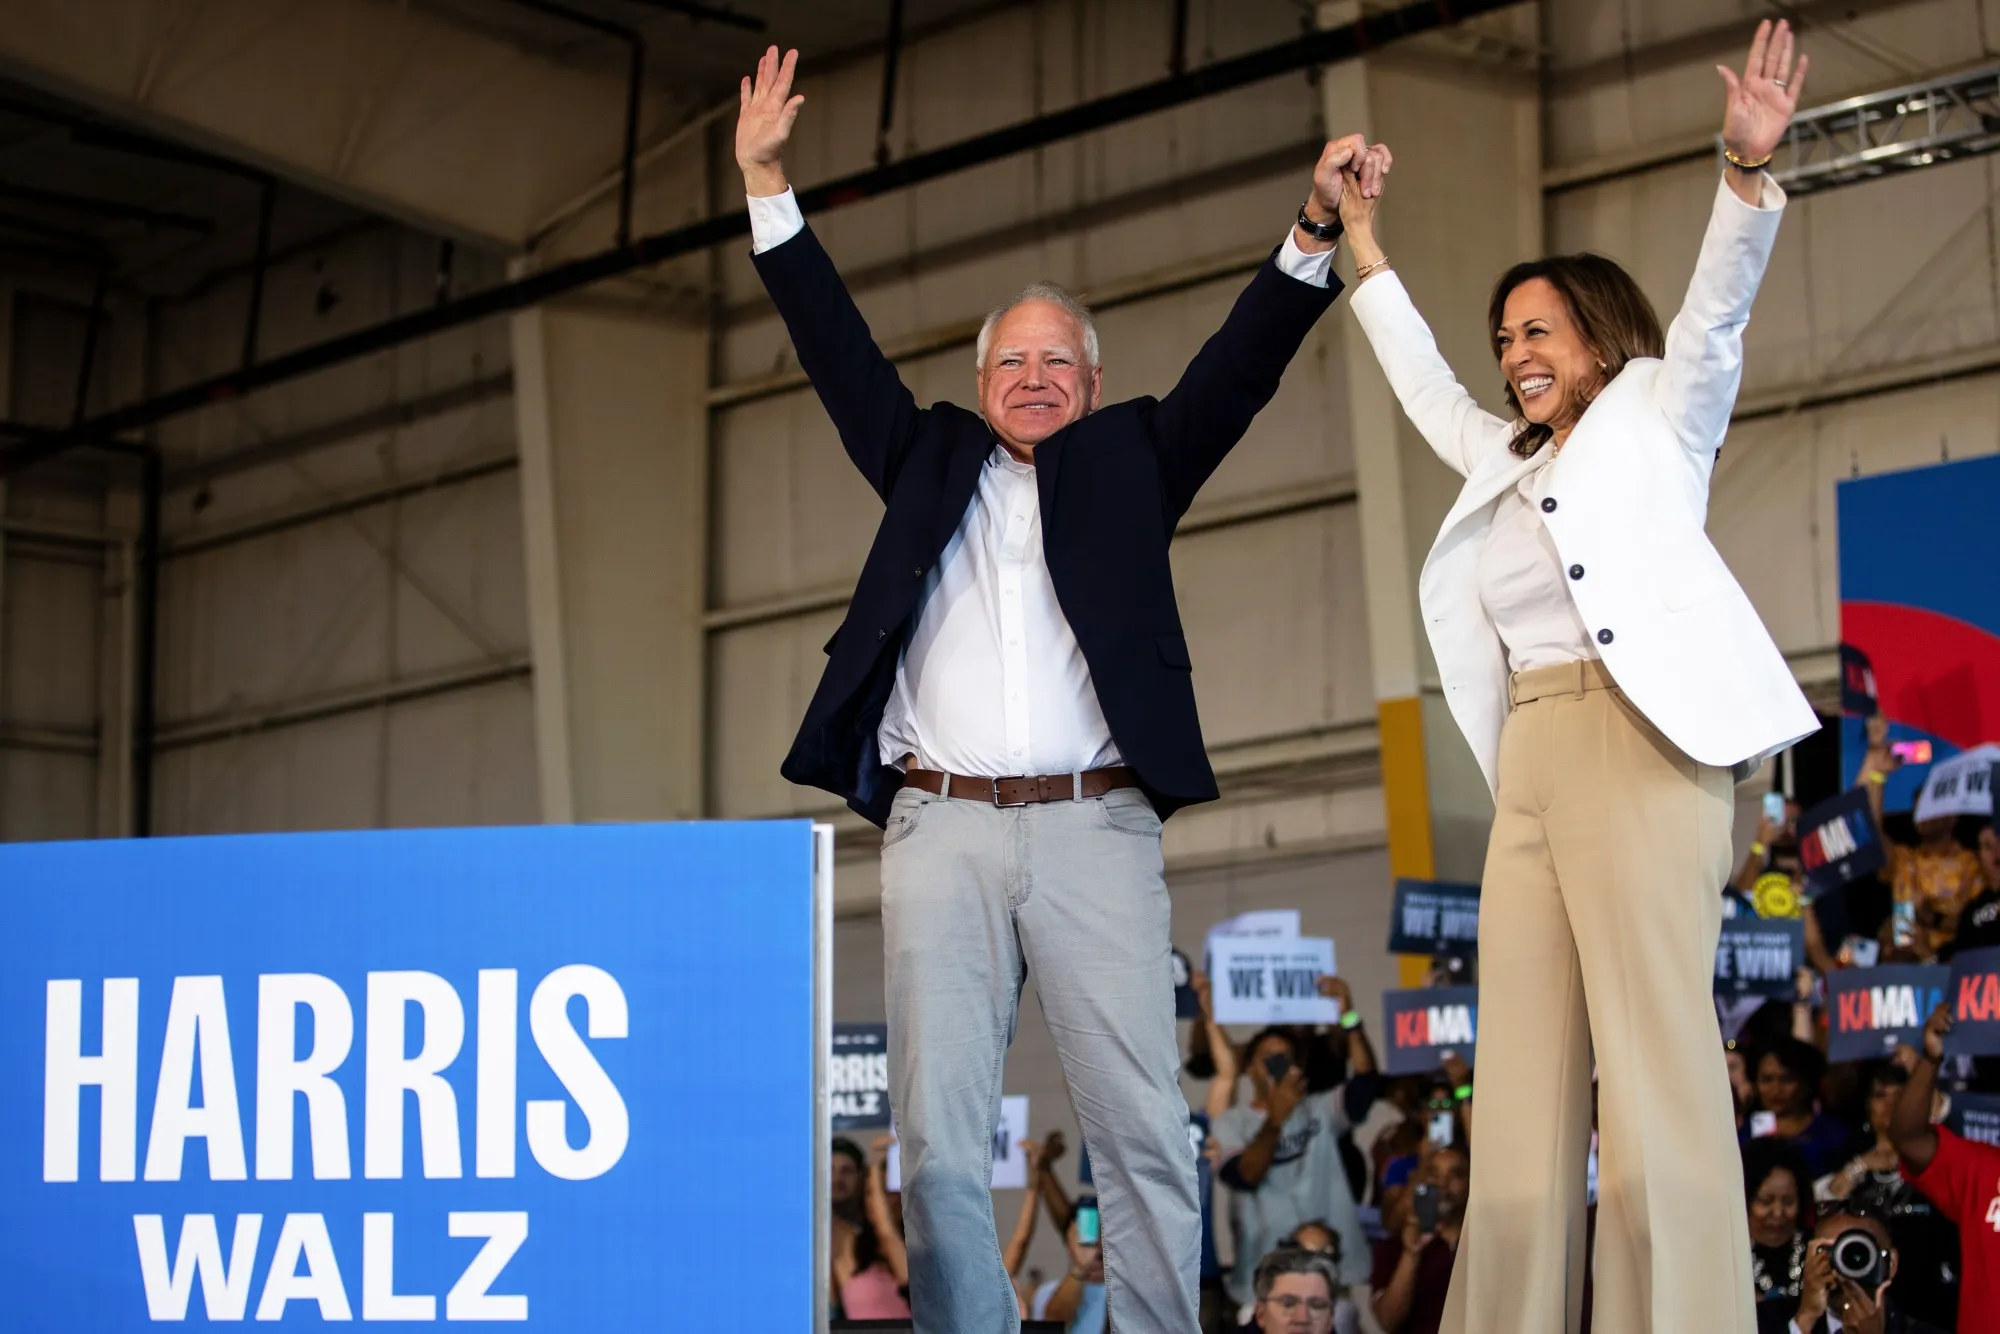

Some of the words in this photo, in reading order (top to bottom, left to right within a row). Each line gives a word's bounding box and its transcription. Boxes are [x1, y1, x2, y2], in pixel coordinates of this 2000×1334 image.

[1403, 907, 1437, 937] WE
[1734, 946, 1792, 980] WIN
[1227, 968, 1264, 999] WE
[43, 964, 629, 1182] HARRIS
[133, 1211, 529, 1322] WALZ
